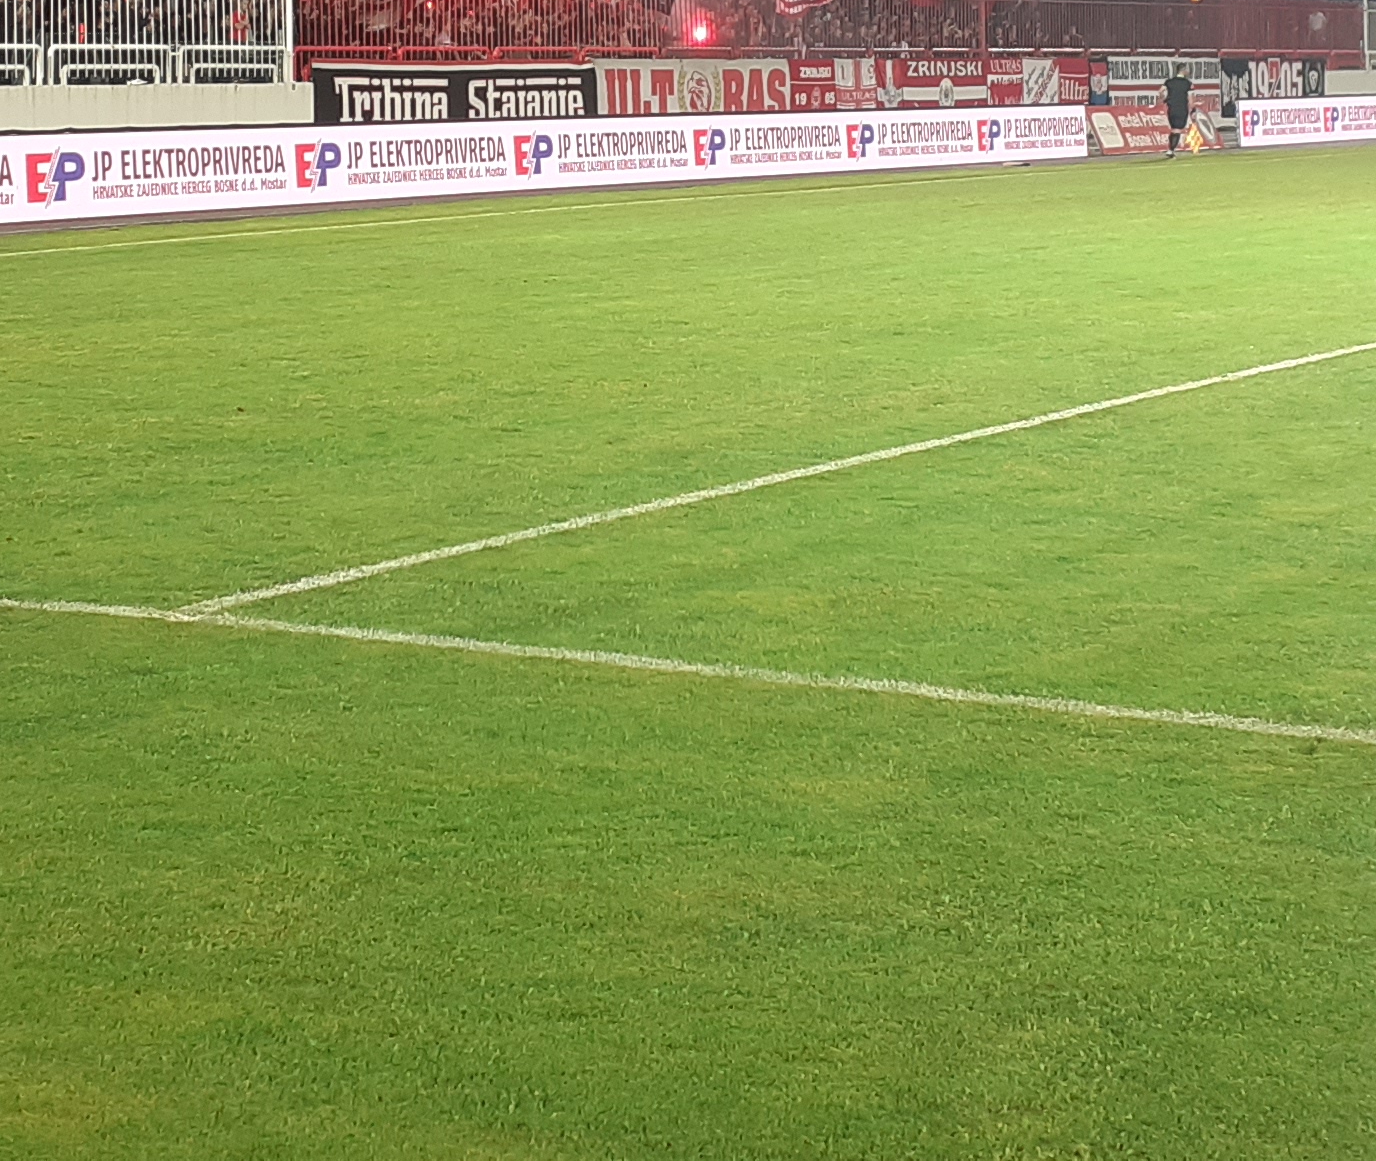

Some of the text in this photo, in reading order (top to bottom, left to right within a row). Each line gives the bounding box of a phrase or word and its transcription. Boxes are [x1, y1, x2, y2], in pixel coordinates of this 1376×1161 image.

[907, 60, 983, 77] ZRINJSKI
[990, 59, 1022, 73] ULTRAS
[722, 68, 787, 111] RAS
[729, 125, 842, 151] JP ELEKTROPRIVREDA
[877, 120, 974, 145] JP ELEKTROPRIVREDA
[976, 119, 1001, 152] EP
[1003, 118, 1013, 139] JP
[1014, 116, 1085, 138] ELEKTROPRIVREDA
[1241, 109, 1260, 137] EP
[347, 136, 507, 169] JP ELEKTROPRIVREDA
[513, 134, 554, 176] EP
[557, 129, 688, 159] JP ELEKTROPRIVREDA
[693, 128, 726, 166] EP
[846, 123, 875, 159] EP
[25, 152, 86, 203] EP
[92, 144, 286, 182] JP ELEKTROPRIVREDA
[294, 142, 342, 188] EP
[92, 177, 287, 200] HRVATSKE ZAJEDNICE HERCEG BOSNE d.d. Mostar
